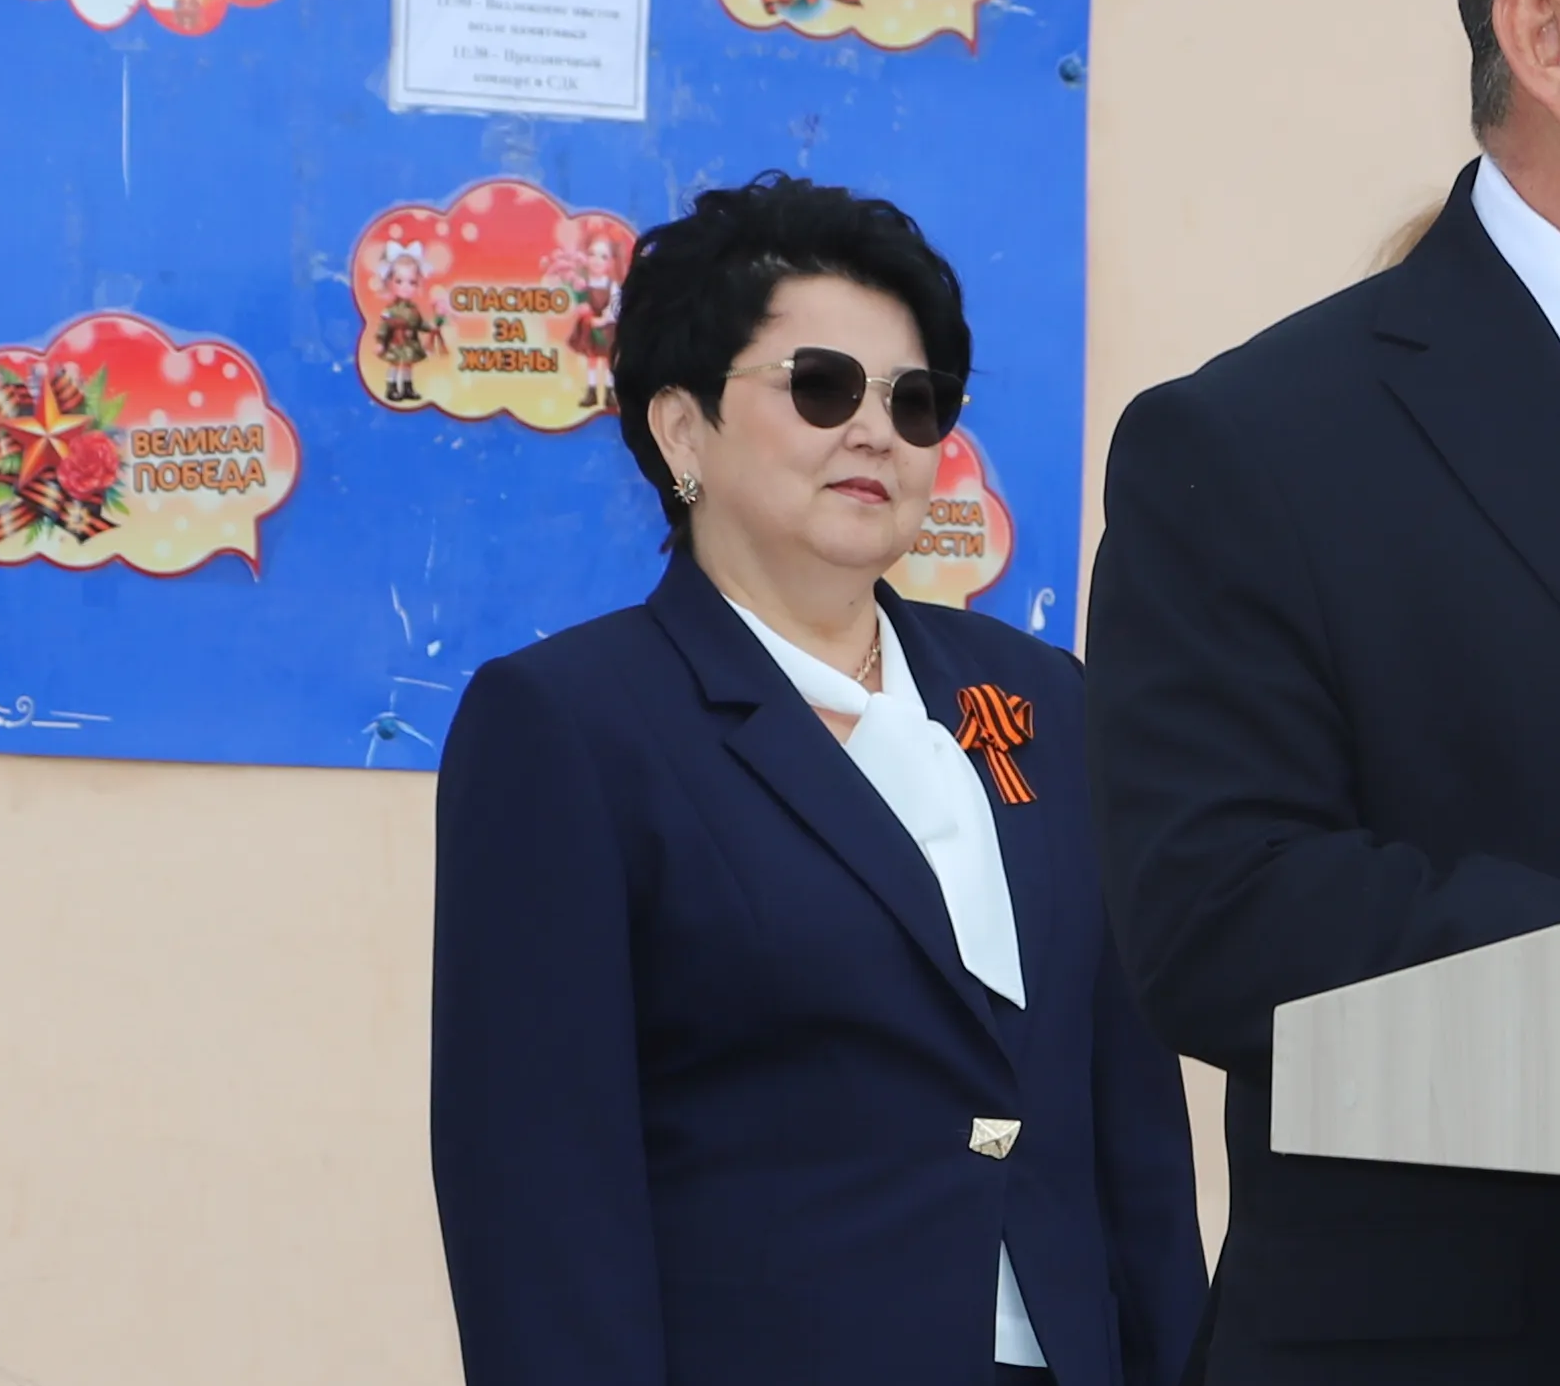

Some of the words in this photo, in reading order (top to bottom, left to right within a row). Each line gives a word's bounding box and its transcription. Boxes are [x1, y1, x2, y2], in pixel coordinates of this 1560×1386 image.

[450, 286, 570, 314] СПАСИБО
[493, 317, 526, 343] ЗА
[458, 347, 558, 373] ЖИЗНЬ!
[131, 424, 264, 458] ВЕЛИКАЯ
[133, 457, 266, 495] ПОБЕДА
[928, 499, 985, 527] ОКА
[908, 530, 985, 558] ОСТИ
